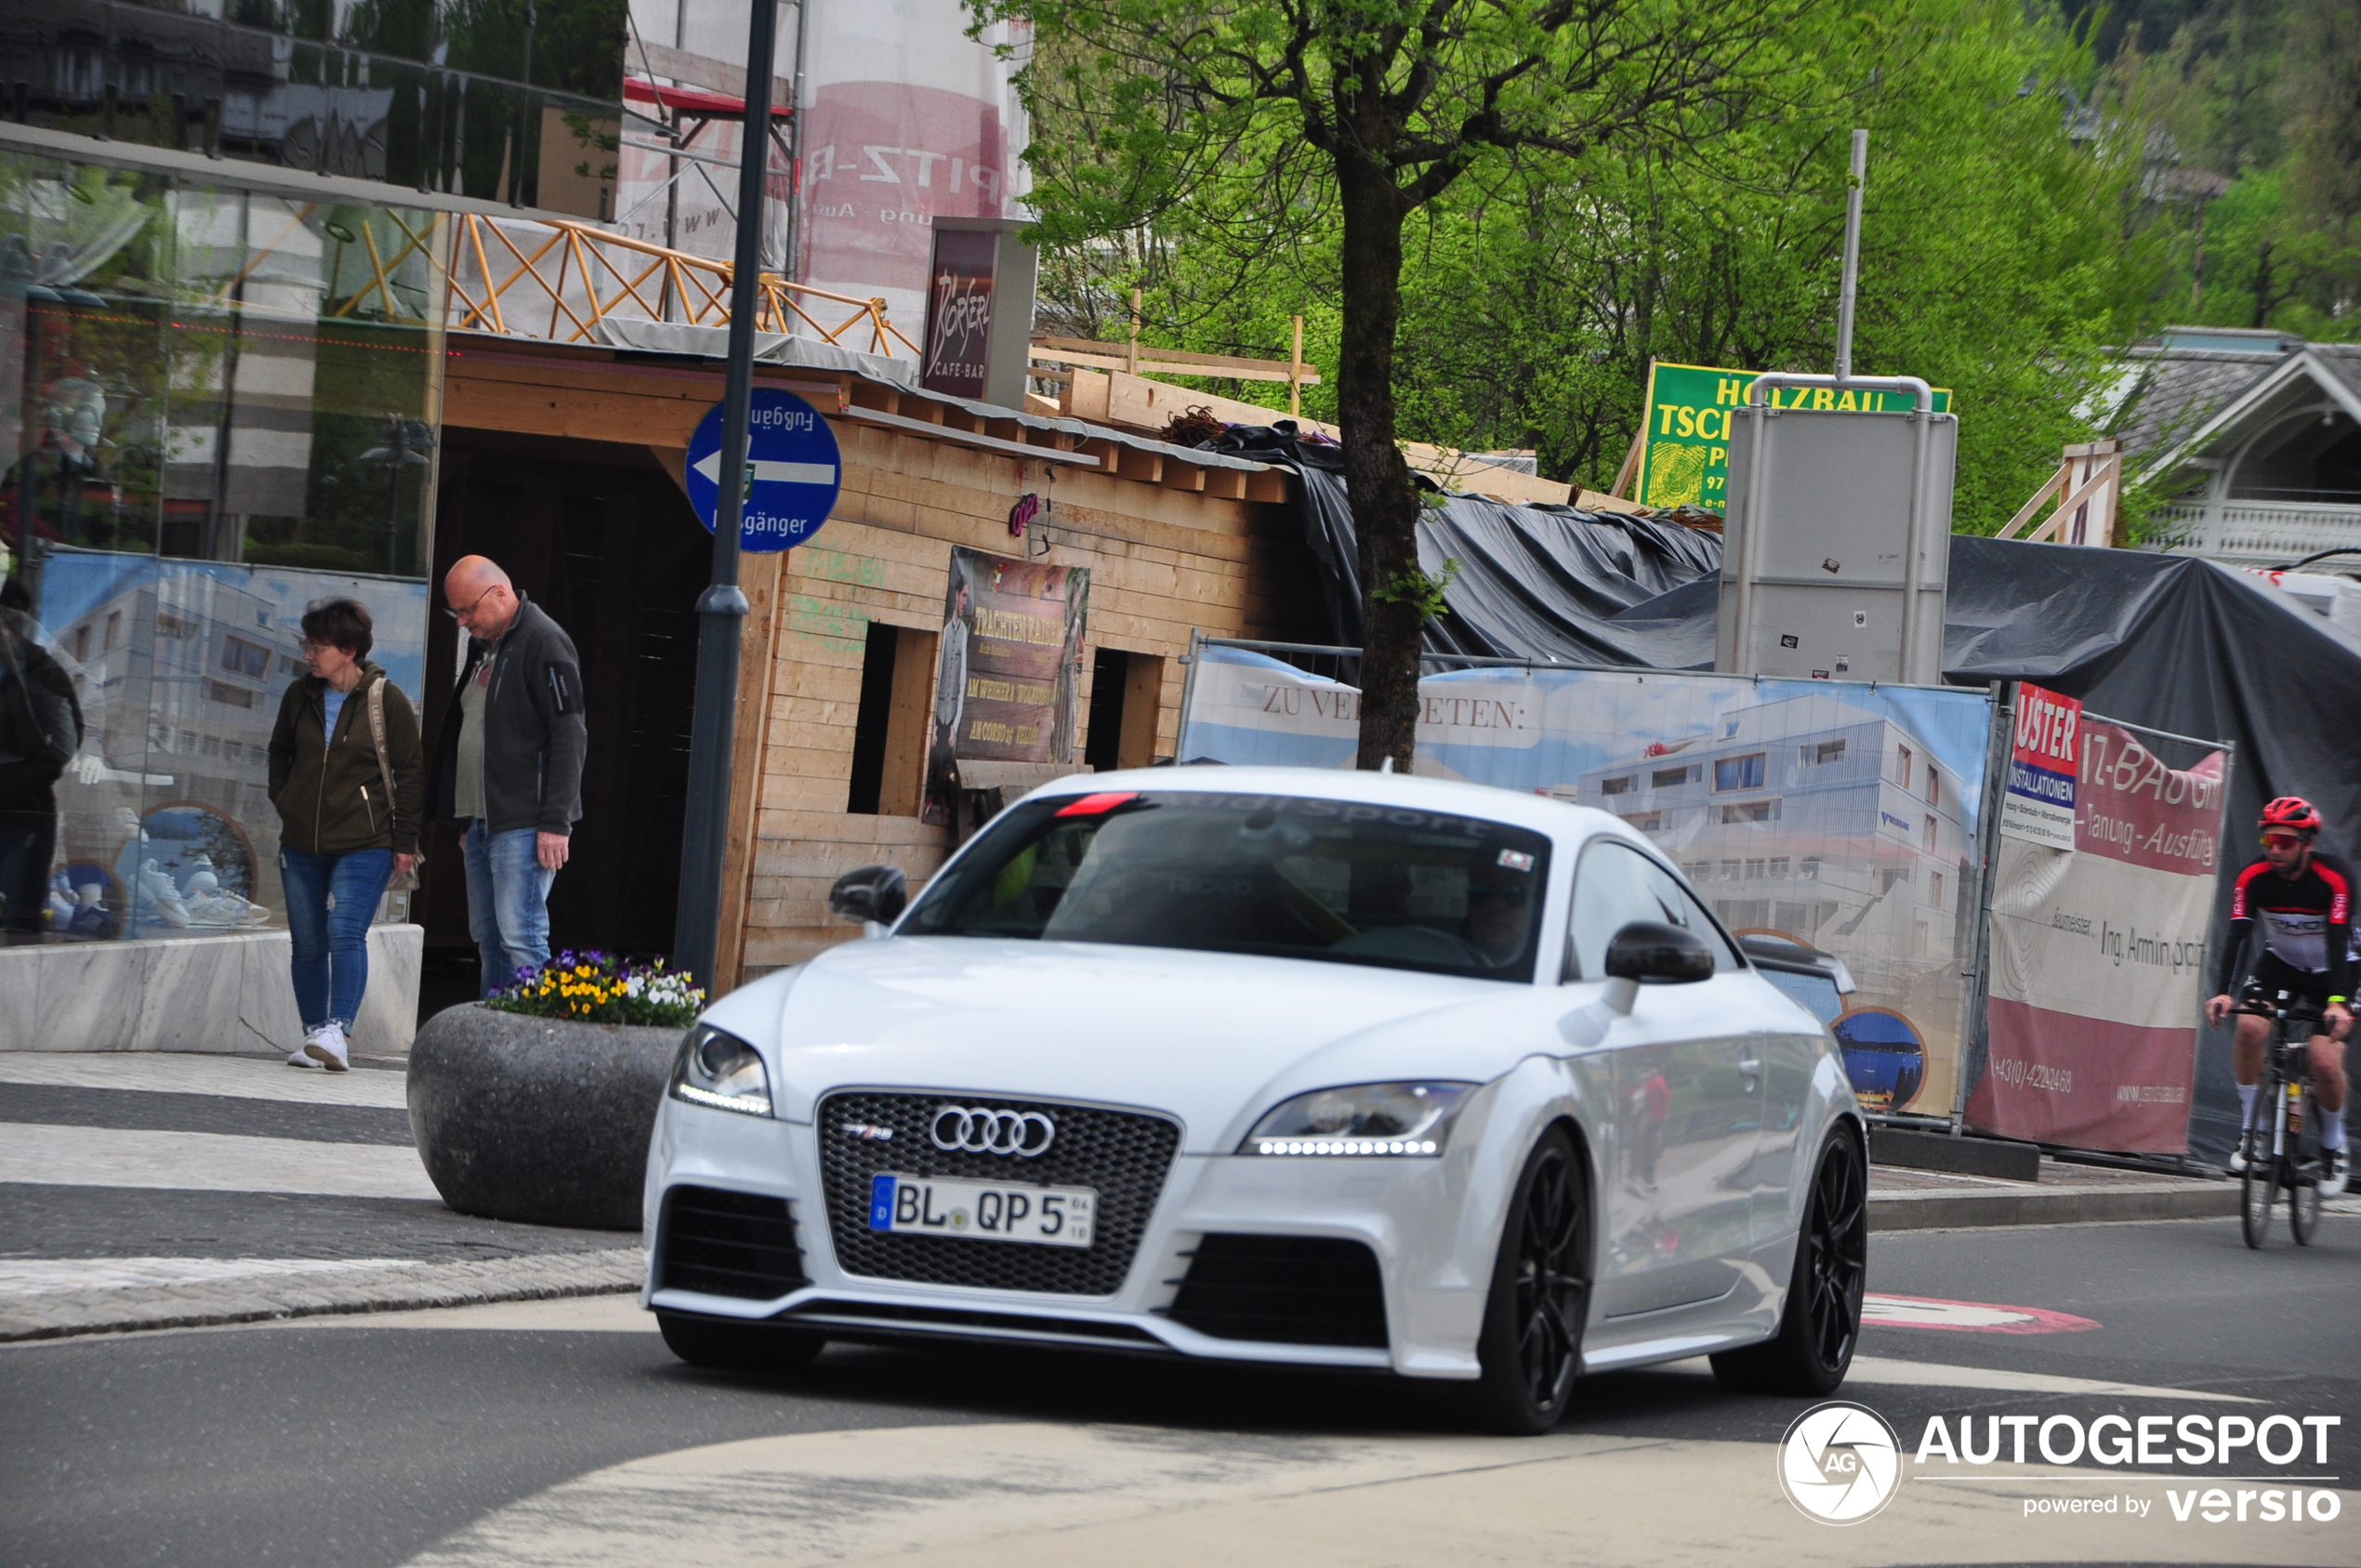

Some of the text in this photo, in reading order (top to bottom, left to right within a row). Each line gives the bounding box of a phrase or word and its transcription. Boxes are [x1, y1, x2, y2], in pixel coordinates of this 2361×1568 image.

[713, 509, 808, 537] gänger
[1263, 684, 1301, 716] ZU
[2101, 920, 2126, 968] Ing.
[895, 1185, 946, 1226] BL
[977, 1192, 1029, 1232] QP
[1040, 1196, 1065, 1235] 5
